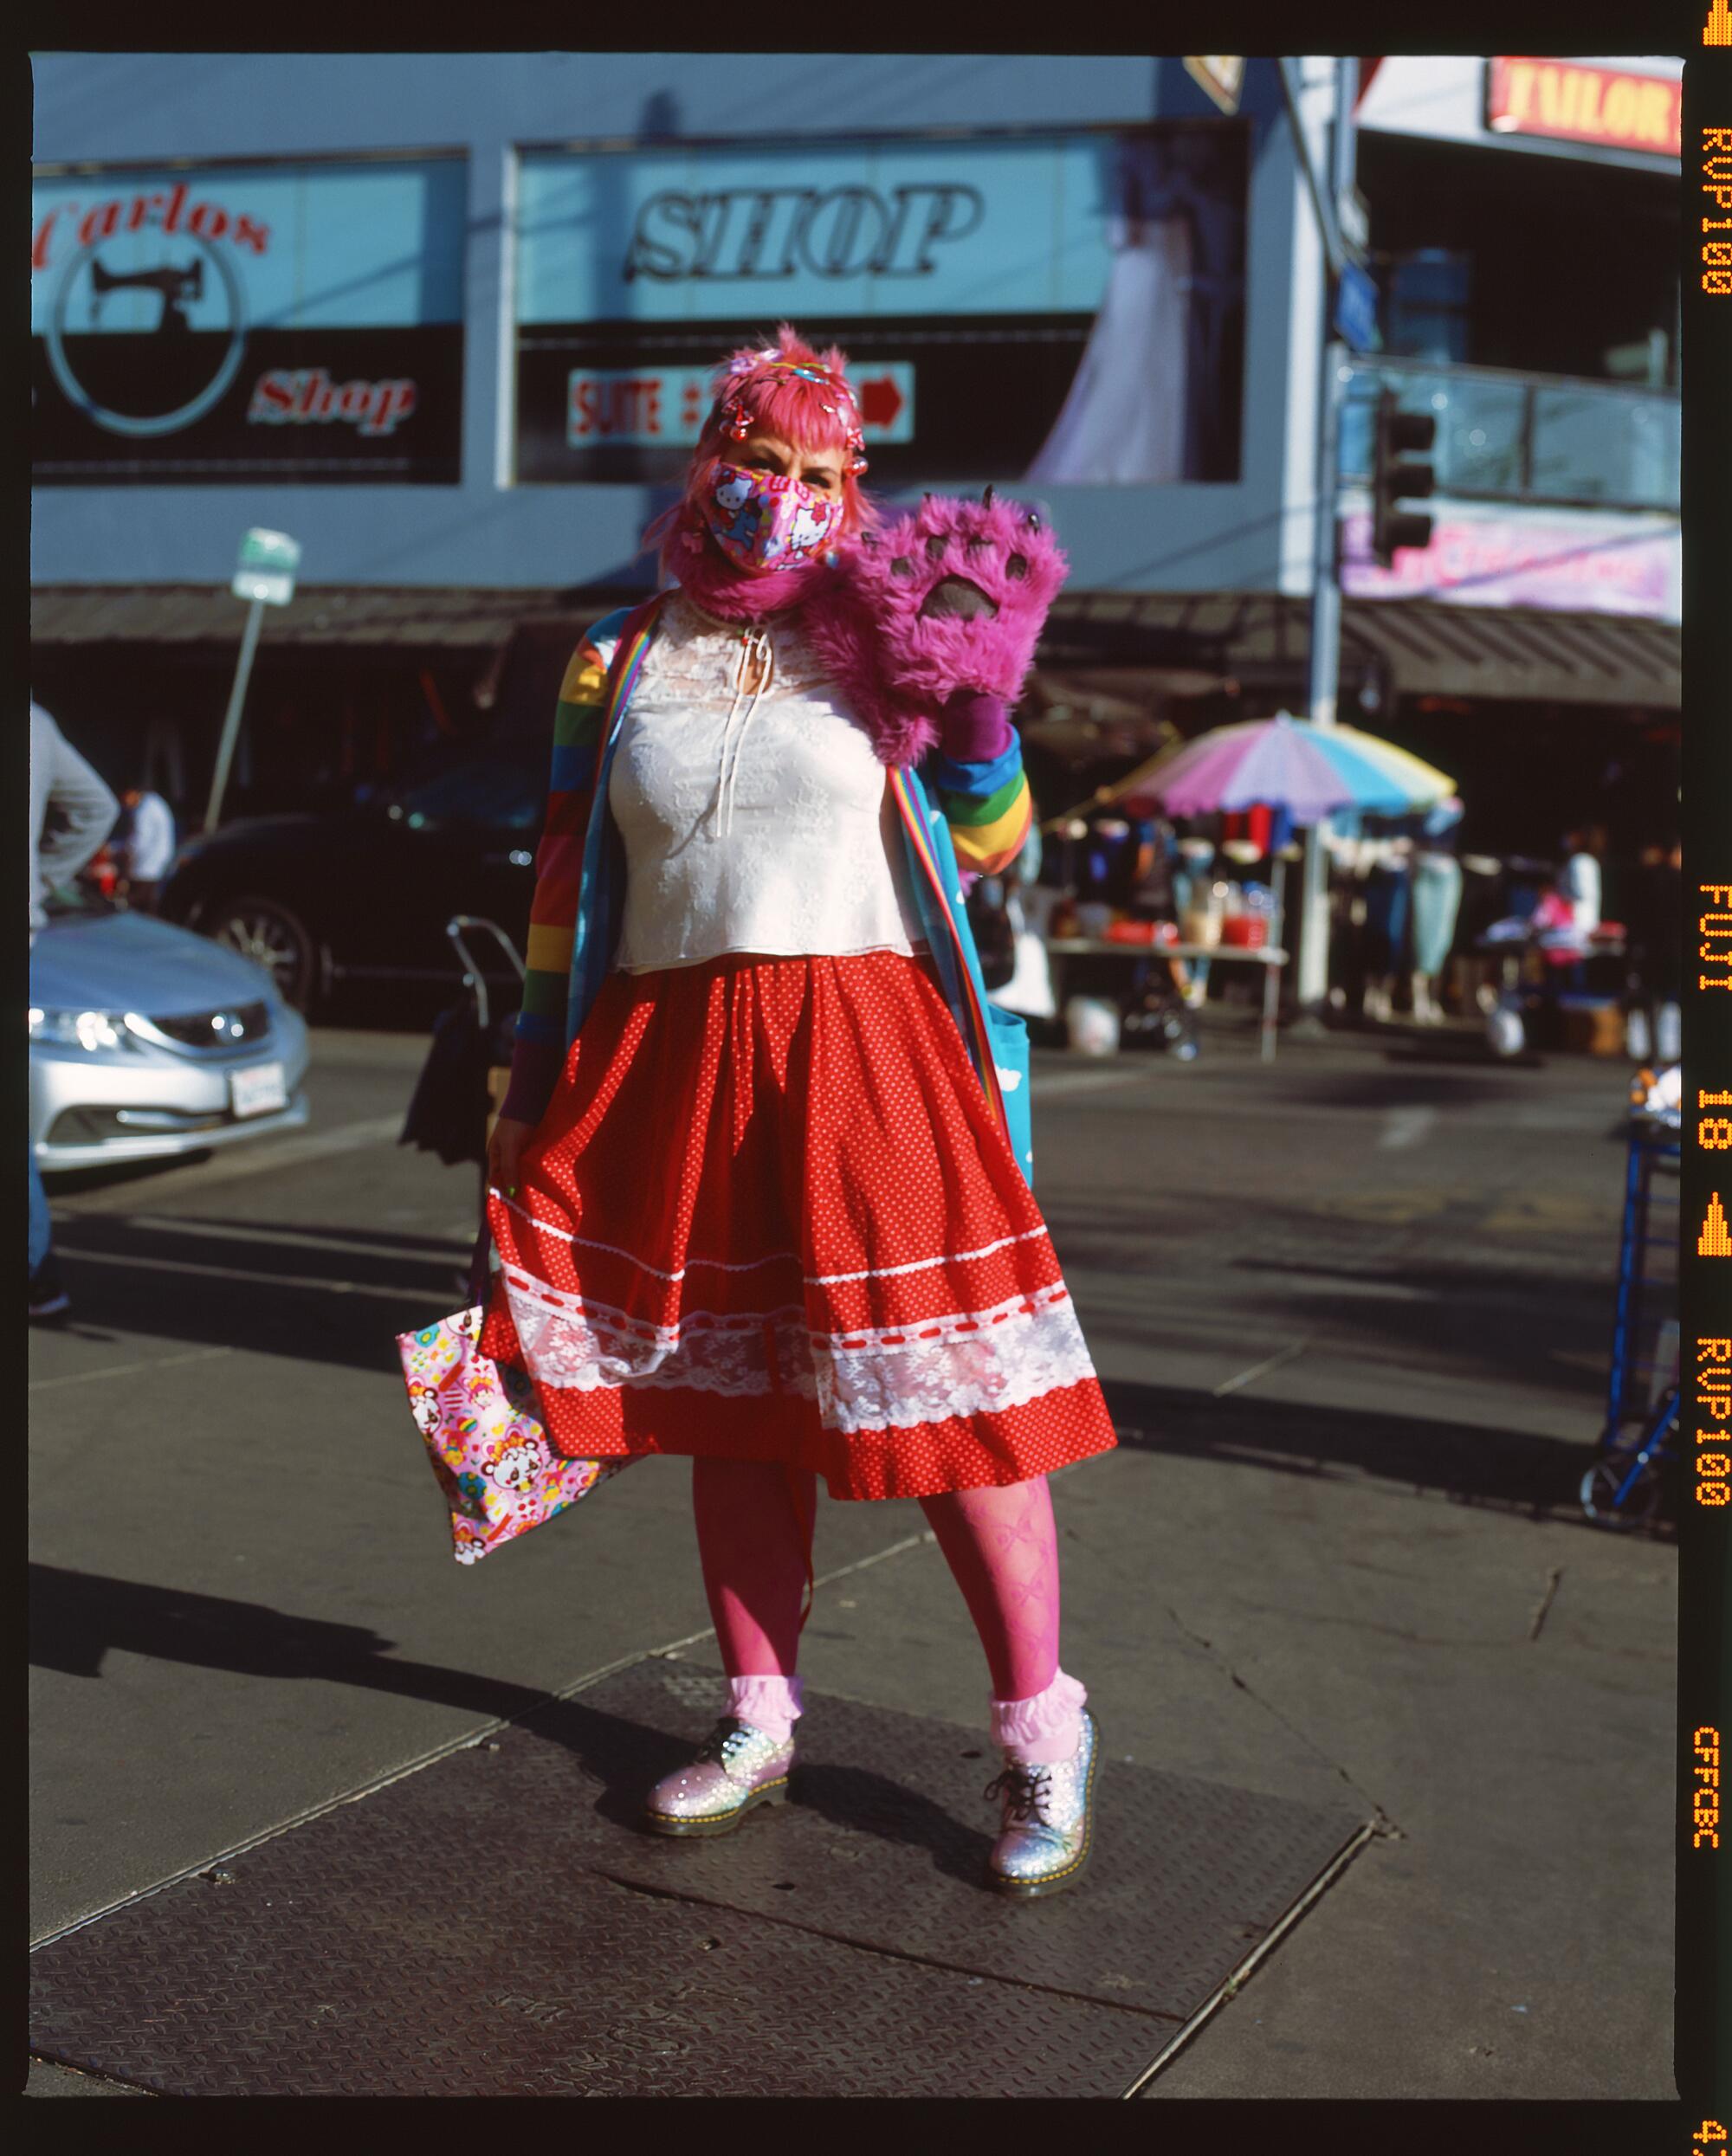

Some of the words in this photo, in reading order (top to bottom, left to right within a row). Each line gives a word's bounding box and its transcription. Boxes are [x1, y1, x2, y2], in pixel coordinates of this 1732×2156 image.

[1505, 61, 1673, 145] TAILOR
[624, 183, 986, 285] SHOP
[1703, 128, 1732, 294] RVP100
[249, 367, 416, 436] Shop
[1699, 884, 1732, 991] FUJI
[1698, 1089, 1732, 1149] 18
[1696, 1338, 1732, 1505] RVP100
[1693, 1727, 1719, 1849] CFFCBC
